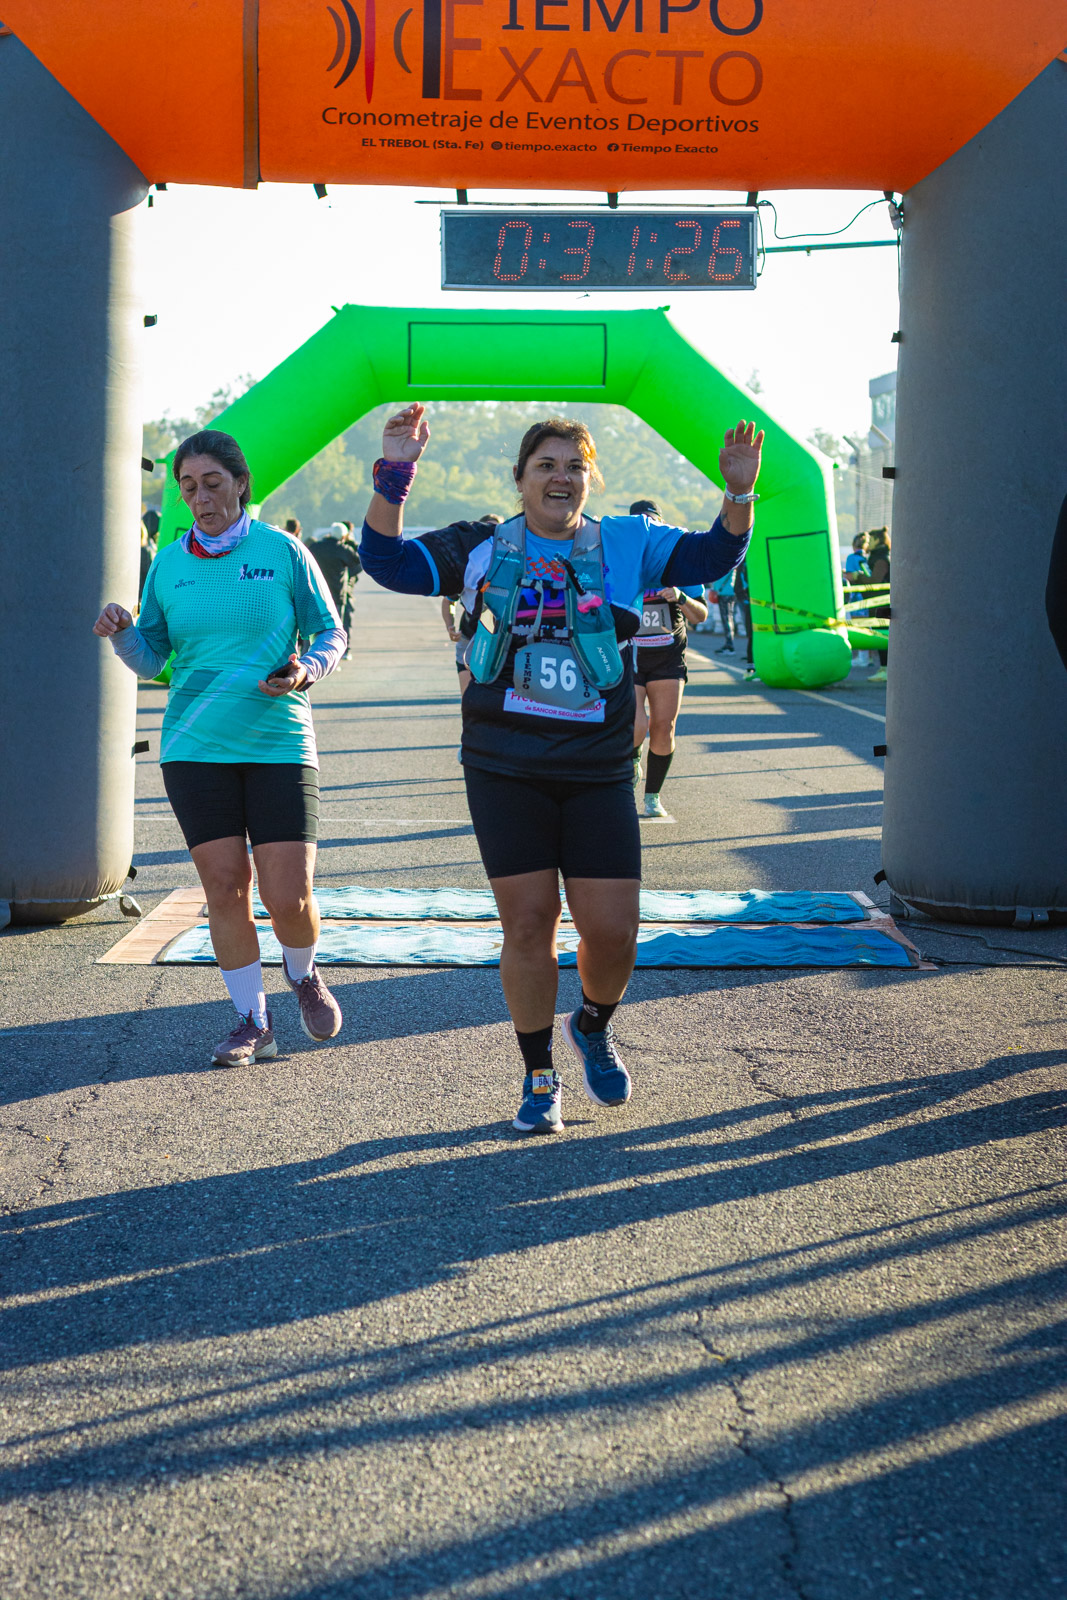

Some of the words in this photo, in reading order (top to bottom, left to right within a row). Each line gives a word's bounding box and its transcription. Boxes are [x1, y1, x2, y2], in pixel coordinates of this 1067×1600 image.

[321, 107, 483, 132] Cronometraje
[489, 110, 519, 129] de
[526, 111, 619, 131] Eventos
[627, 113, 759, 135] Deportivos
[361, 138, 377, 147] EL
[379, 138, 430, 149] TREBOL
[433, 140, 462, 150] (Sta.
[465, 140, 484, 151] Fe)
[505, 141, 597, 153] tiempo.exacto
[621, 143, 672, 154] Tiempo
[675, 144, 719, 154] Exacto
[240, 563, 275, 581] km
[642, 611, 660, 627] 62
[522, 652, 533, 690] TIEMPO
[539, 656, 577, 692] 56
[532, 706, 558, 715] SANCOR
[558, 710, 587, 719] SEGUROS
